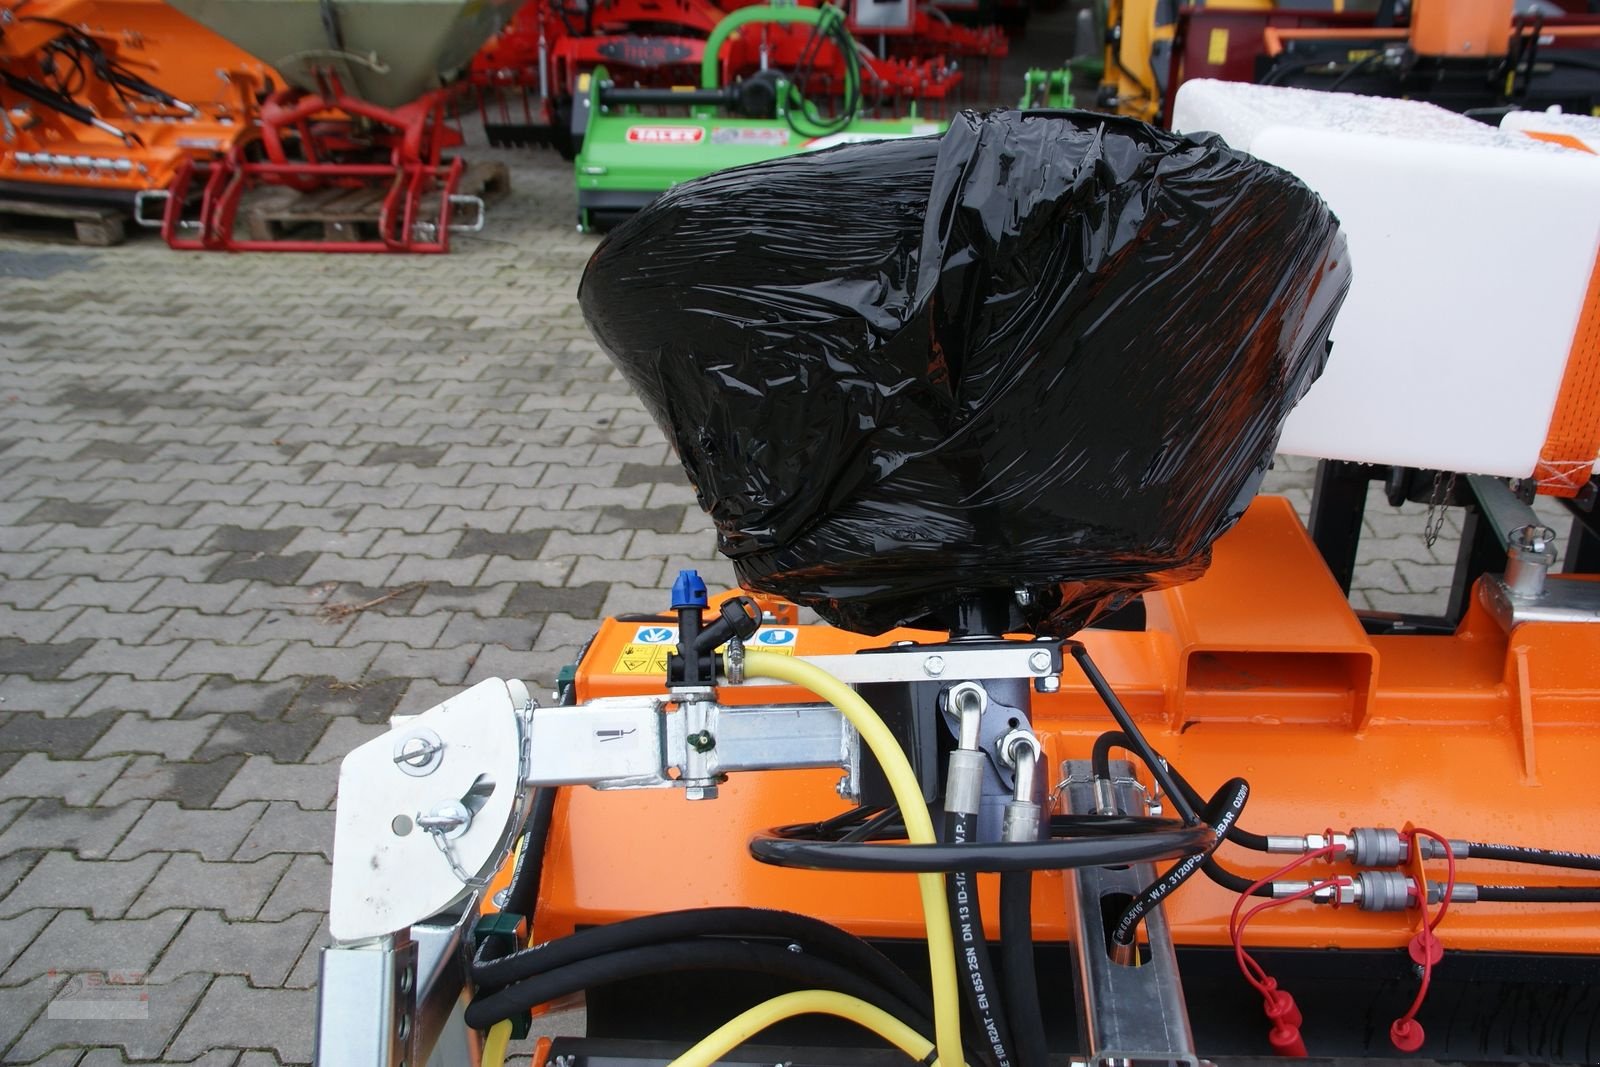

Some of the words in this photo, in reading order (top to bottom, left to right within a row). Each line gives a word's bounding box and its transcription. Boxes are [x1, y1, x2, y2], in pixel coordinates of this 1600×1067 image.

[959, 907, 969, 920] 13
[961, 923, 973, 942] DN
[965, 947, 979, 971] 2SN
[971, 972, 985, 992] 853
[977, 993, 989, 1010] EN
[984, 1017, 1001, 1044] R2AT
[993, 1043, 1006, 1059] 100
